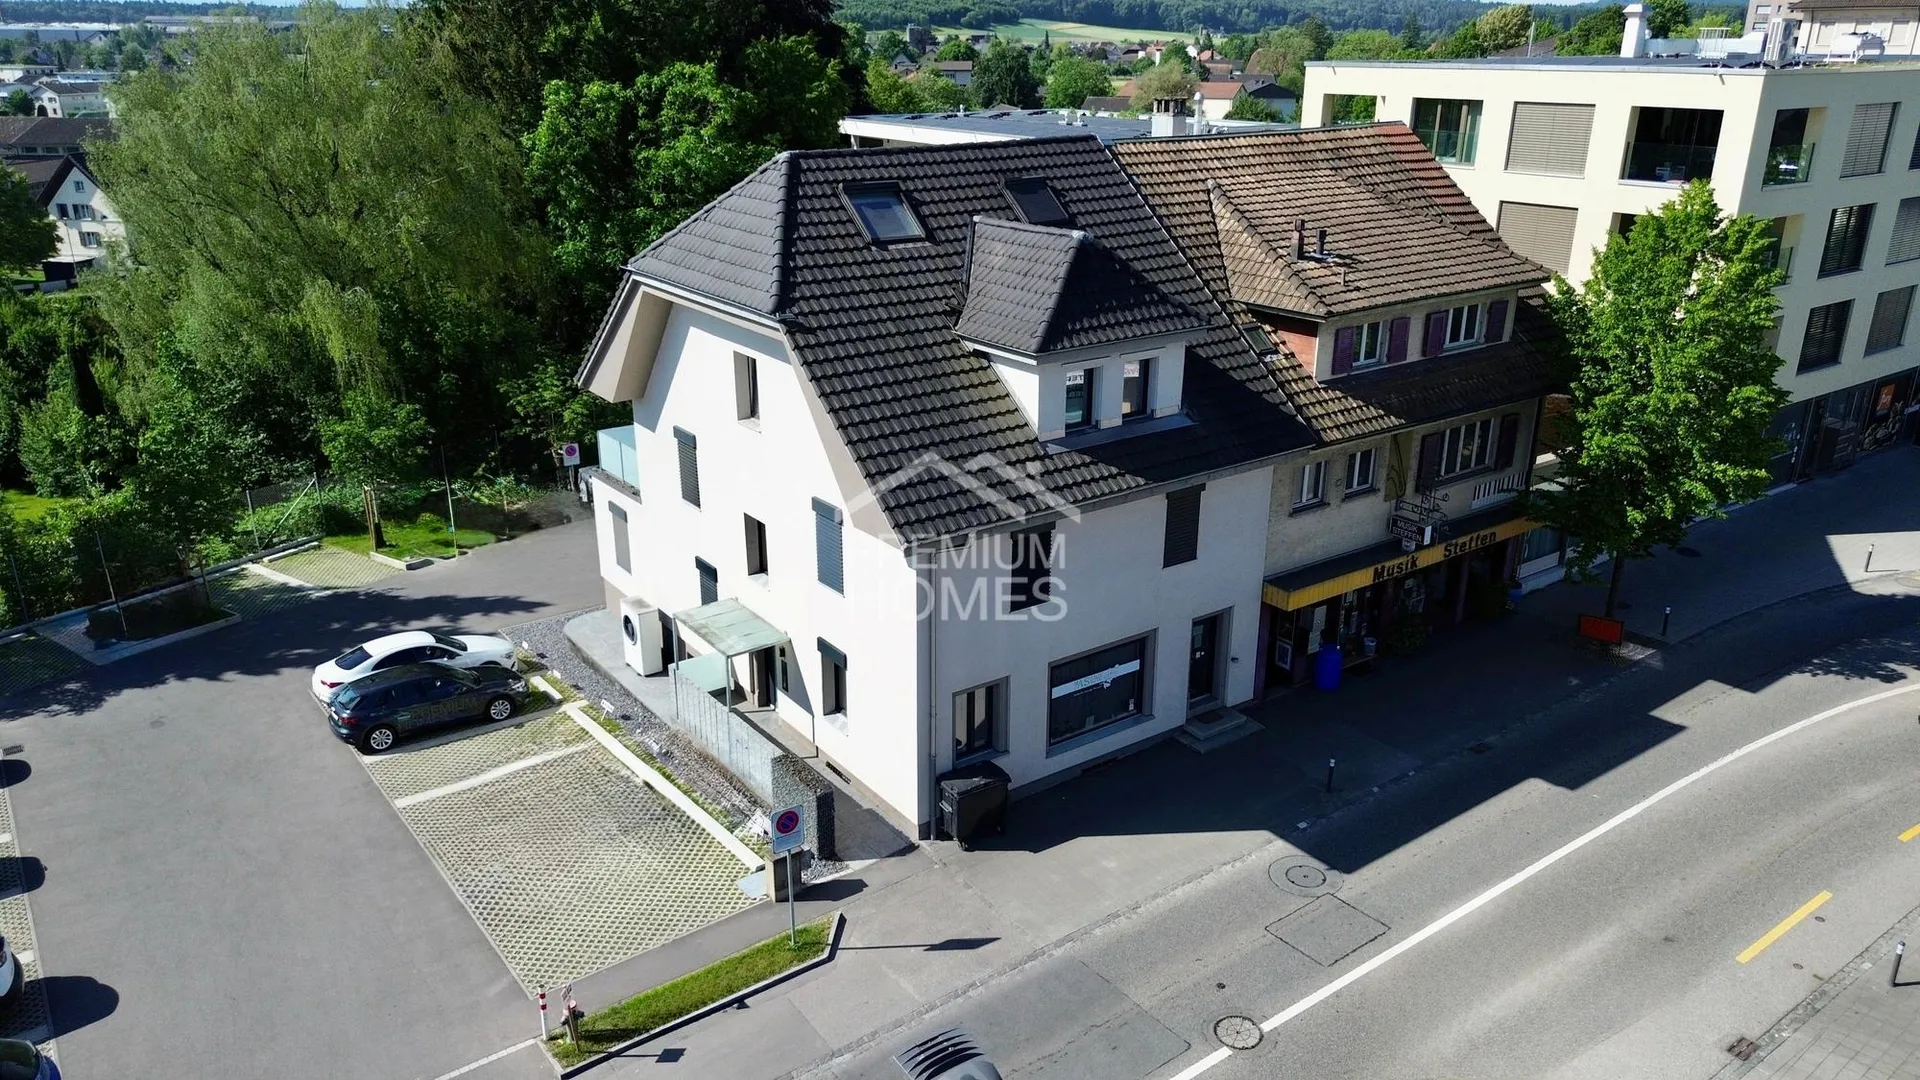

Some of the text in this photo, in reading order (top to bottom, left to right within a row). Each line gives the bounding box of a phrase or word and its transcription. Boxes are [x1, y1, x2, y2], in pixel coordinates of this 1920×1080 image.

[1393, 526, 1422, 542] STEFFEN
[1397, 520, 1418, 533] MUSIK
[1372, 553, 1419, 583] Musik
[1443, 531, 1497, 559] Steffen
